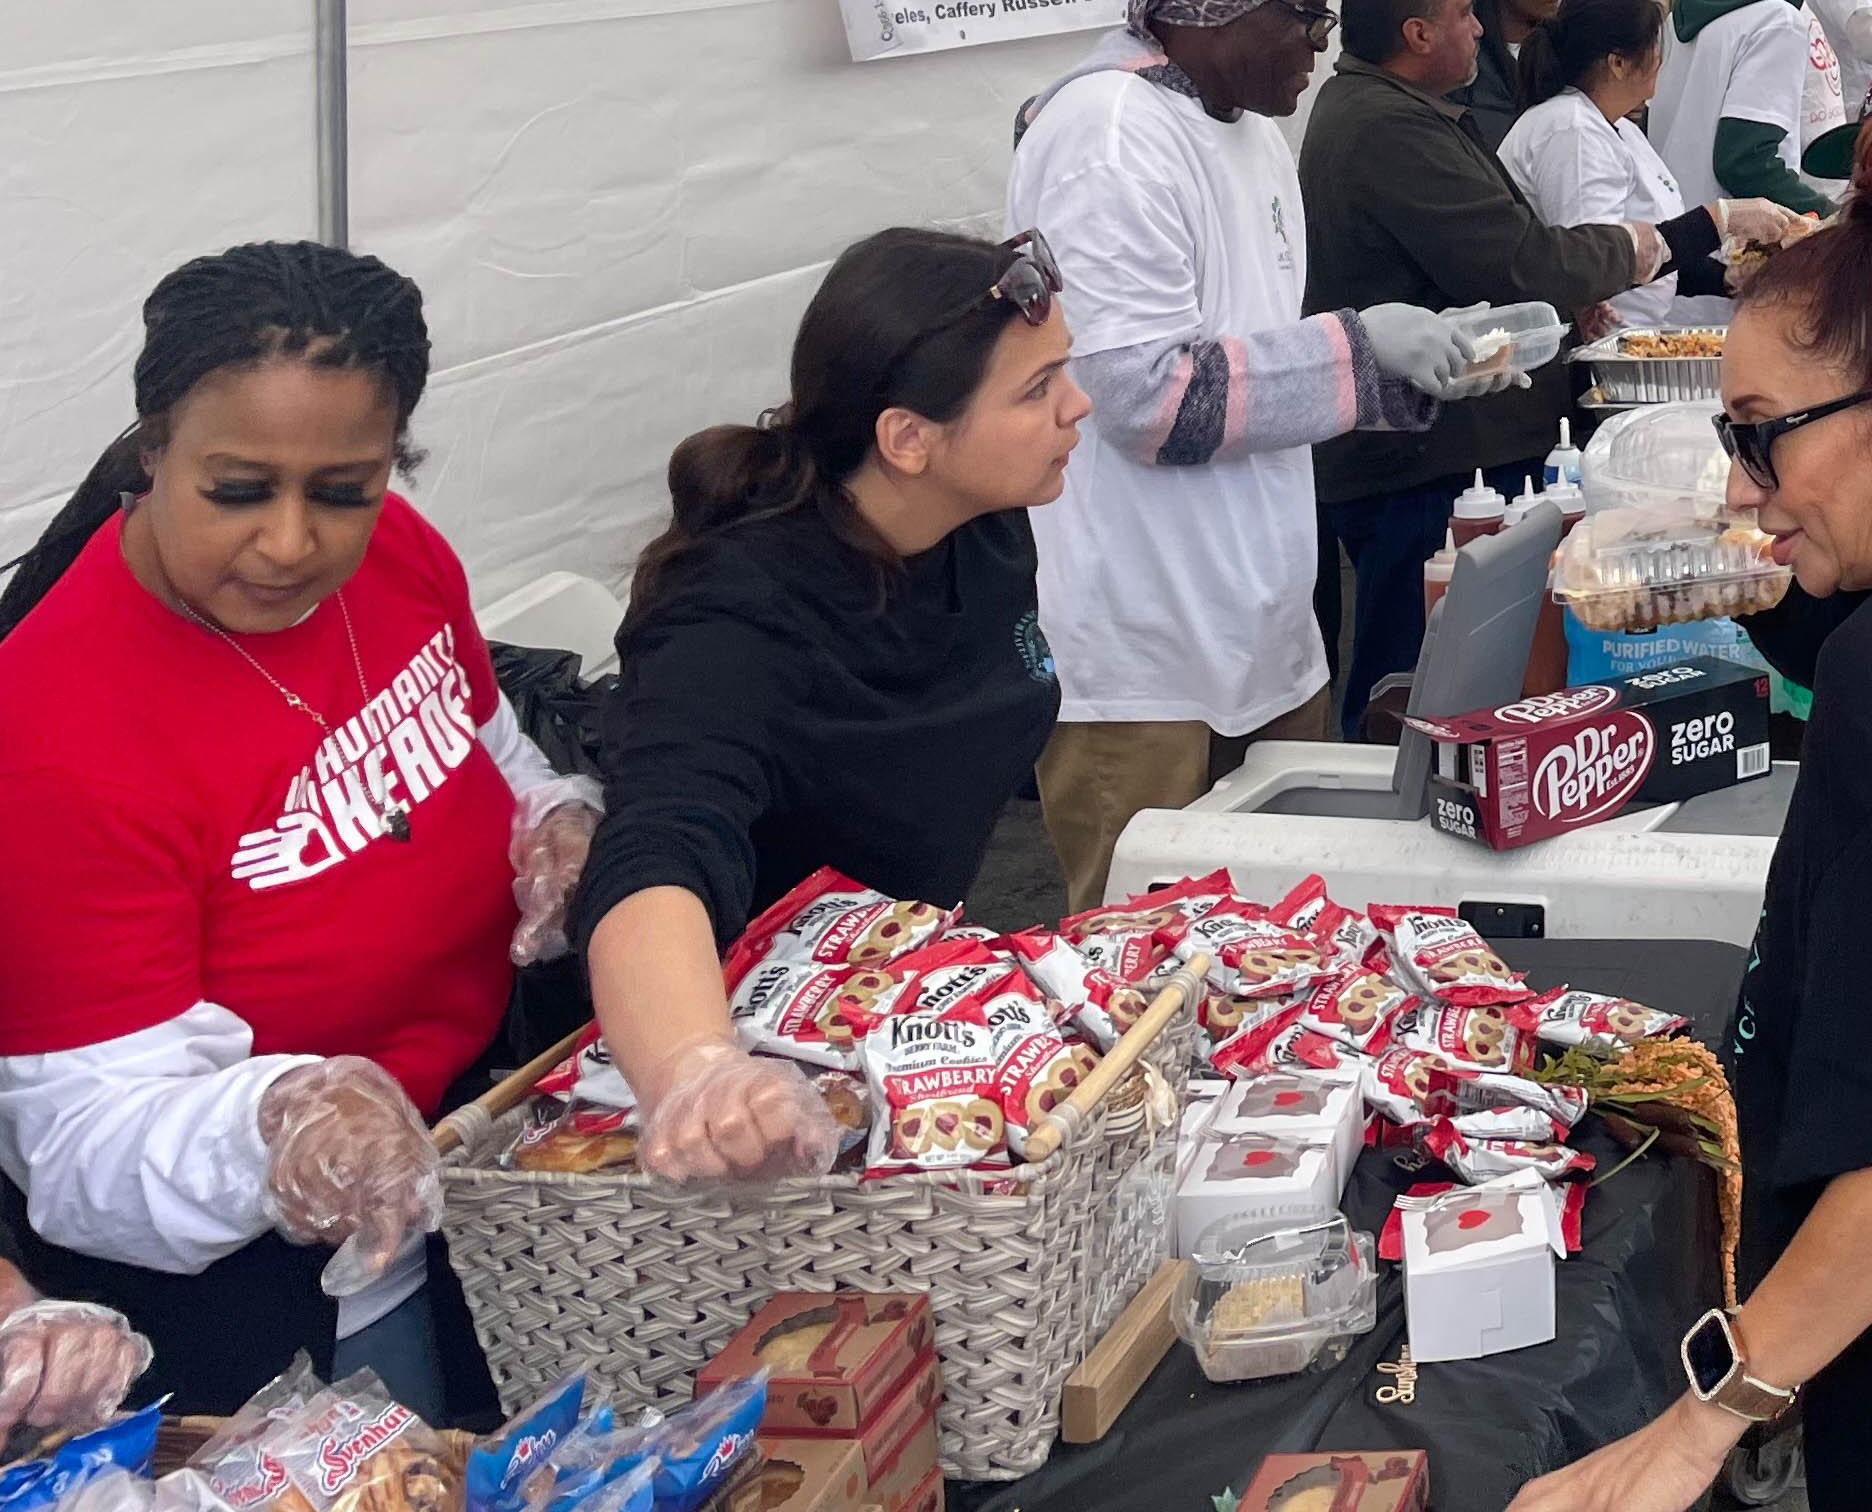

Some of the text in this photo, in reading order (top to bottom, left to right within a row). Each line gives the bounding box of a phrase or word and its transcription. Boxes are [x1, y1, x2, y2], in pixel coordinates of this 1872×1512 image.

[895, 6, 931, 25] eles,
[935, 0, 996, 20] Caffery
[1603, 638, 1742, 659] PURIFIED WATER
[1520, 690, 1564, 707] Dr
[1754, 676, 1769, 693] 12
[1501, 687, 1602, 724] Pepper
[1671, 711, 1735, 747] zero
[1574, 724, 1617, 773] Dr
[1671, 734, 1735, 765] SUGAR
[1546, 731, 1645, 820] Pepper
[1436, 798, 1474, 825] zero
[1439, 816, 1477, 839] SUGAR
[921, 966, 987, 1008] nott's
[988, 1000, 1031, 1025] ott's
[892, 1068, 996, 1096] STRAWBERRY
[323, 1403, 412, 1487] Svenhar
